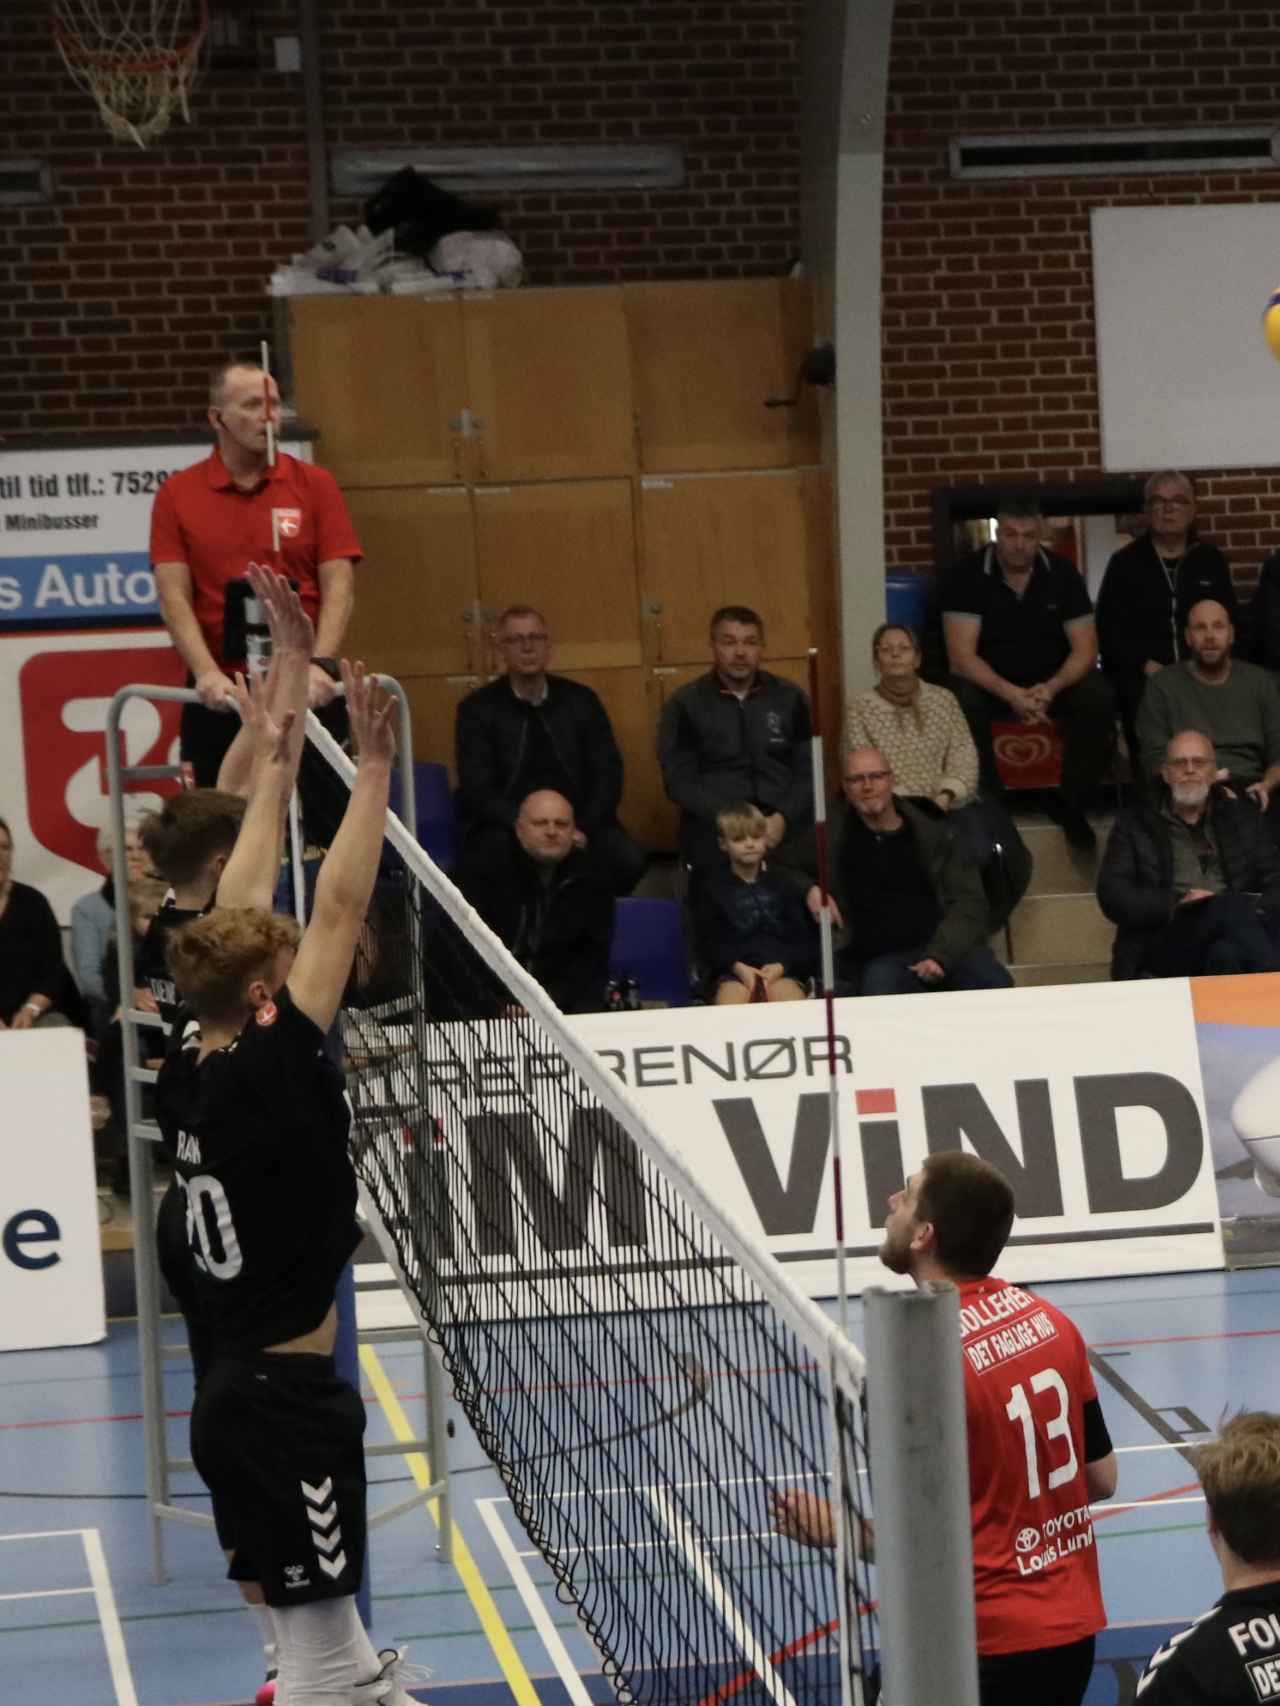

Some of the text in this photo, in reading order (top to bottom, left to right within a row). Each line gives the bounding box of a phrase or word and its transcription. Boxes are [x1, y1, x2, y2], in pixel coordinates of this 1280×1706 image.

[29, 474, 58, 498] tid
[6, 514, 99, 531] Minibusser
[34, 562, 158, 608] Auto
[967, 1311, 1055, 1371] DET FAGLIGE HUS
[1006, 1368, 1078, 1500] 13
[1042, 1505, 1091, 1539] TOYOTA
[1016, 1545, 1057, 1576] Louis
